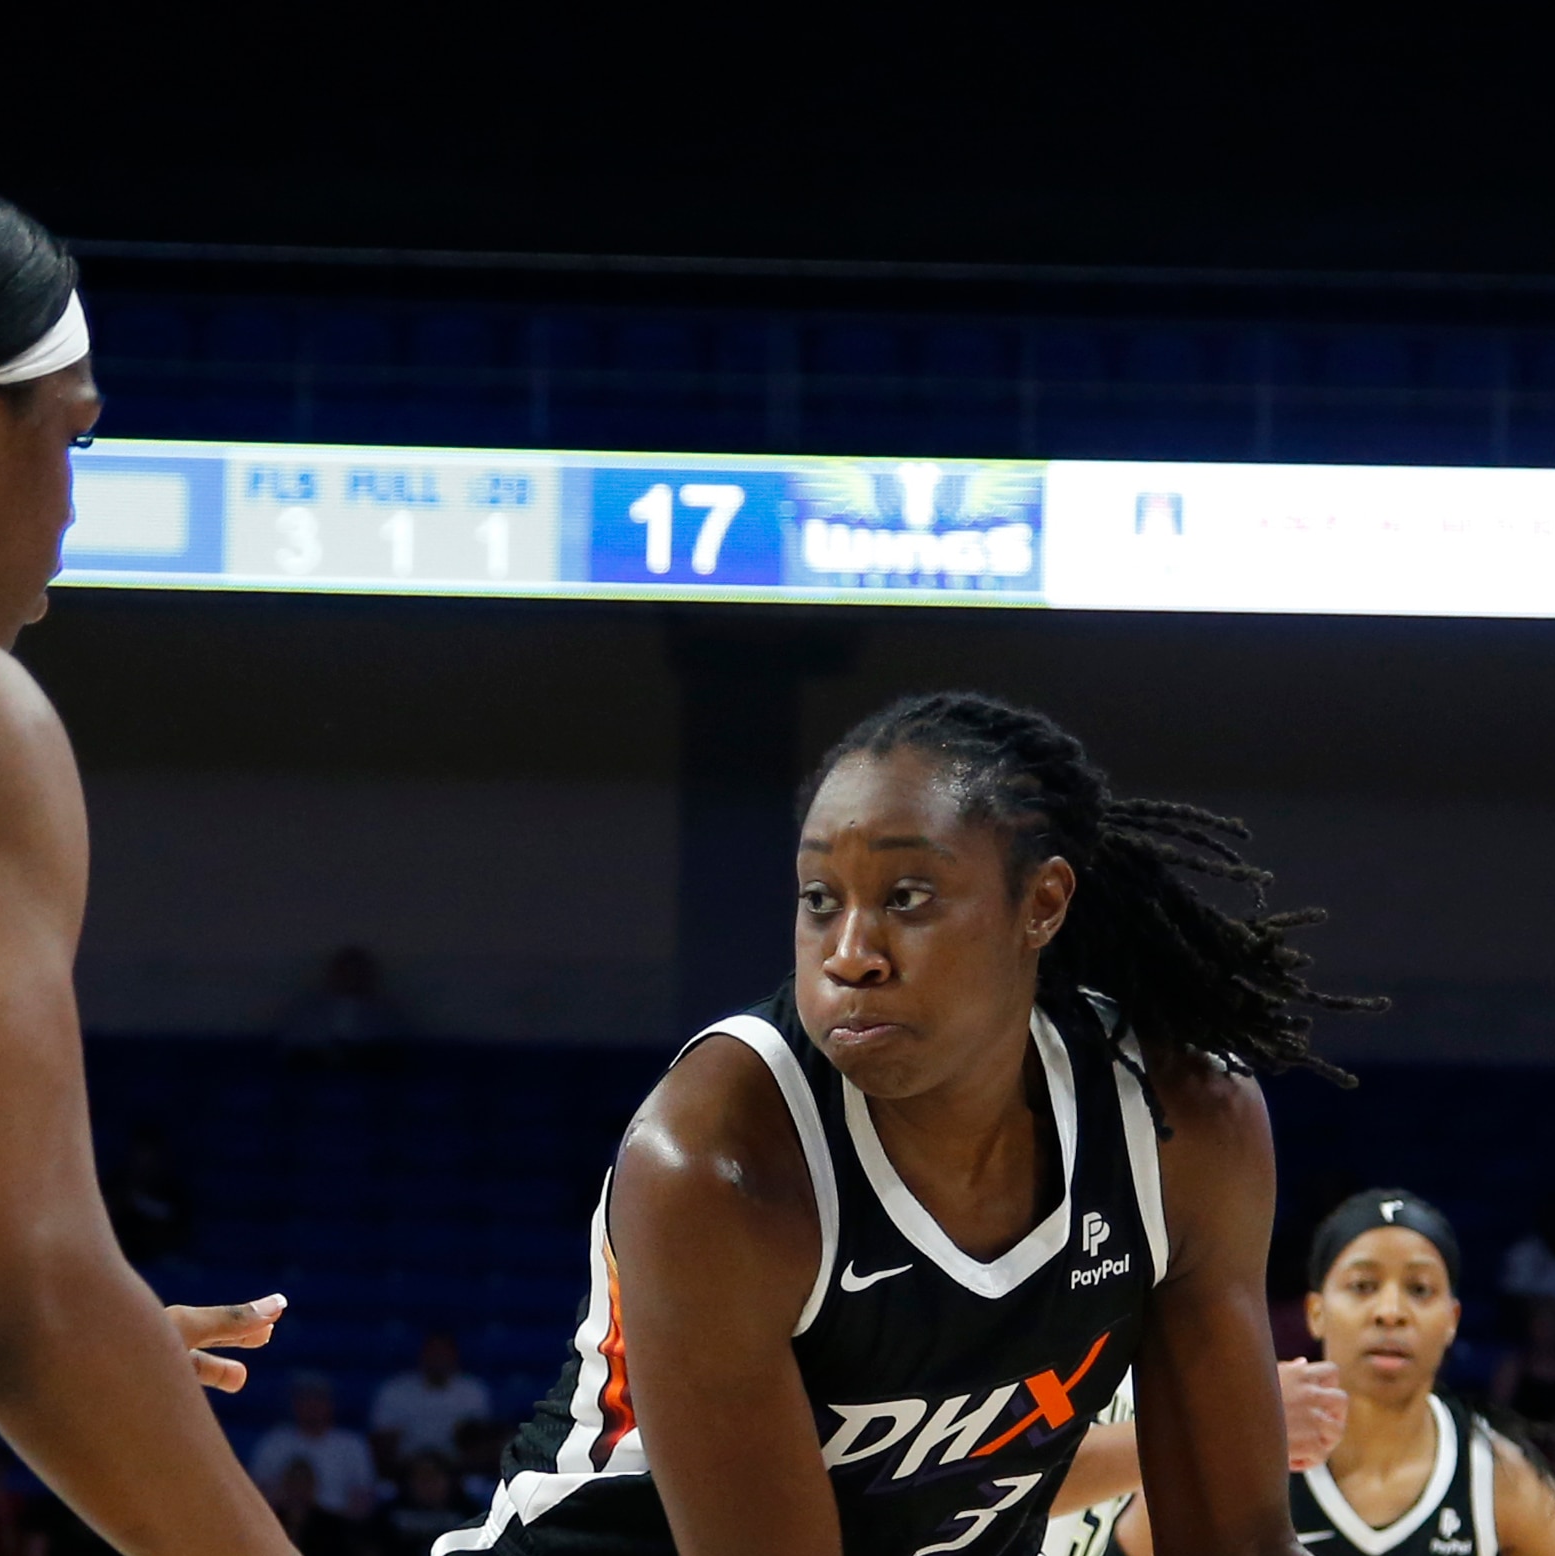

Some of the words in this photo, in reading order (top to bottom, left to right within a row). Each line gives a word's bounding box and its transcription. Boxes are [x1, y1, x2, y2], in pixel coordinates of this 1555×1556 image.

[274, 506, 323, 576] 3
[378, 509, 414, 578] 1
[474, 511, 510, 580] 1
[628, 483, 745, 576] 17
[1070, 1253, 1130, 1291] PayPal
